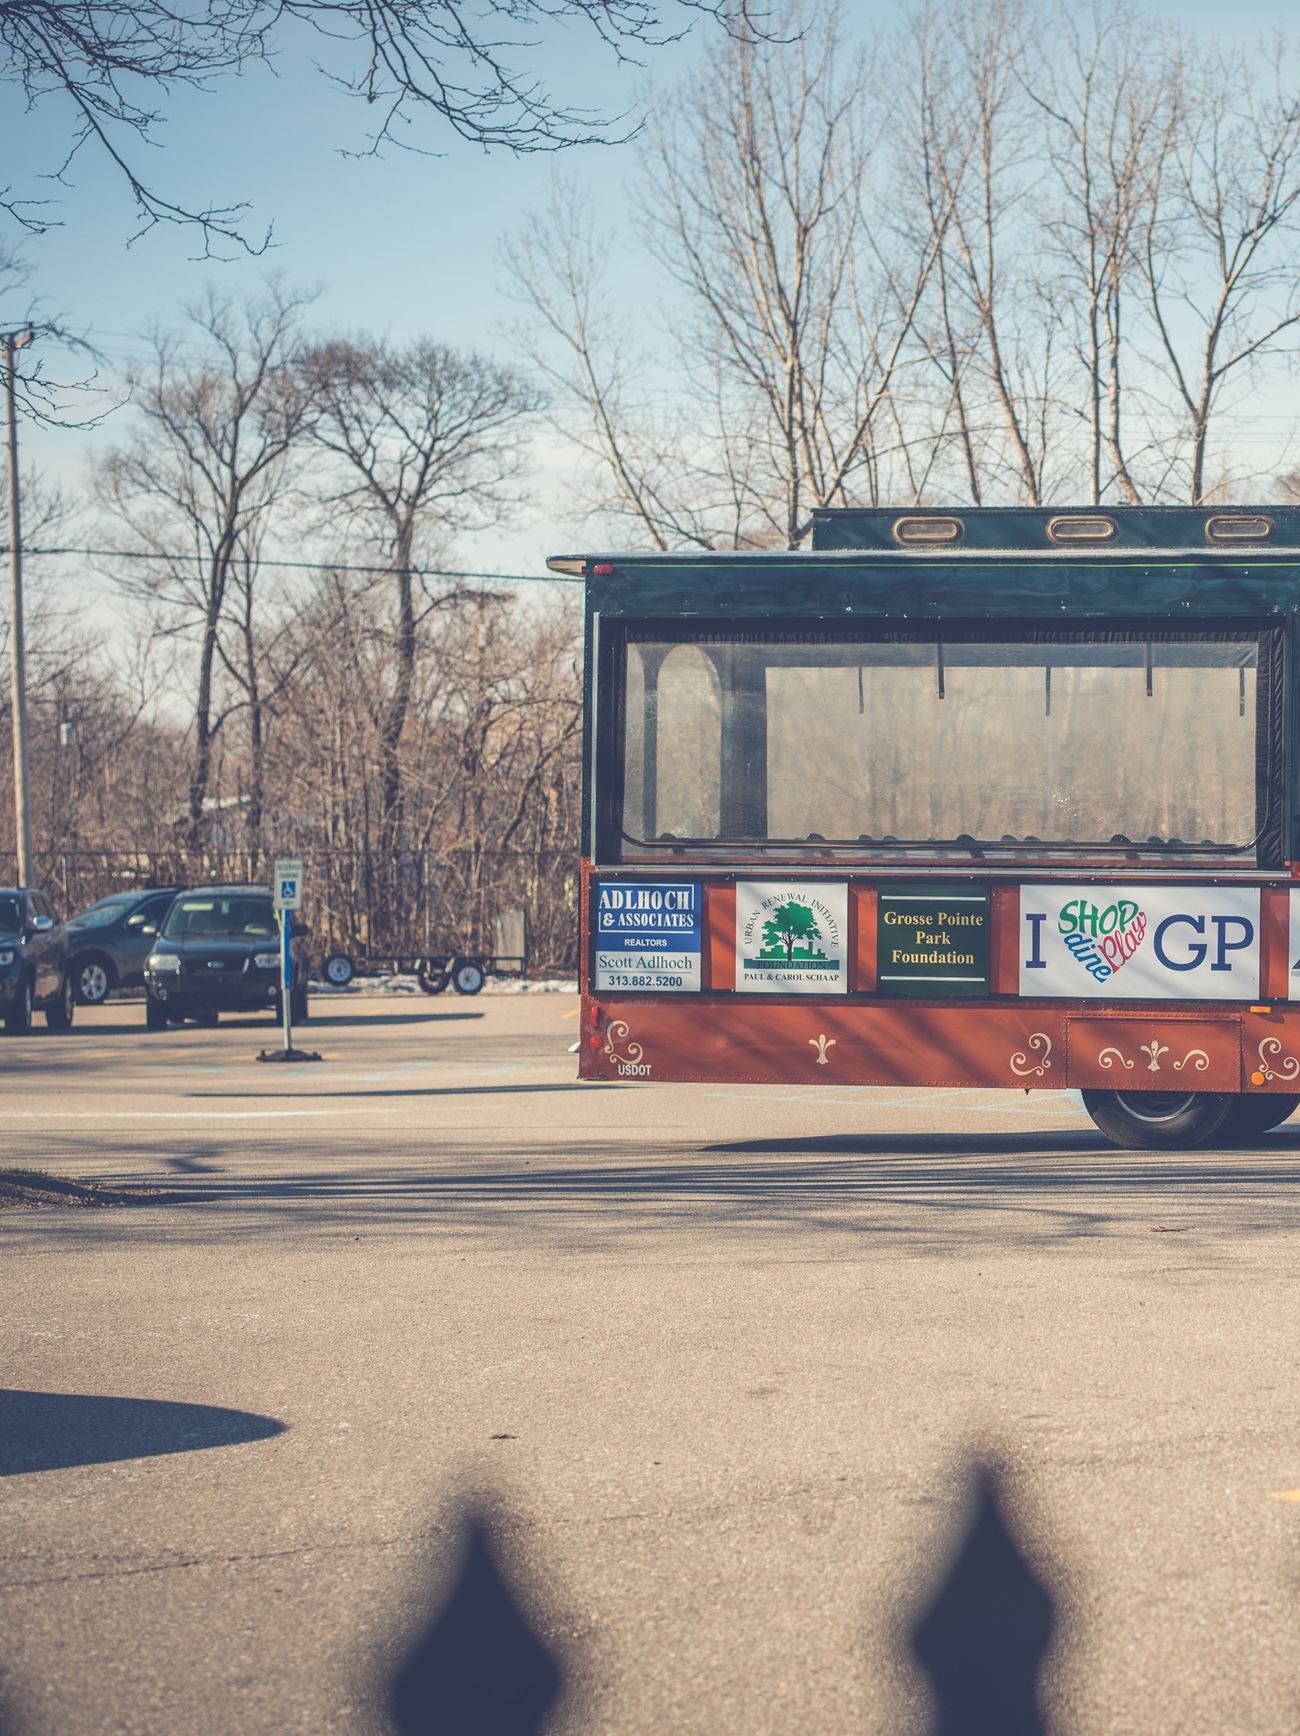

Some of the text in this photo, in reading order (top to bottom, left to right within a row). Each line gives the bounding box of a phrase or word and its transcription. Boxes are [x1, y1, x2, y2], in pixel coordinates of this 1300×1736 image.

[599, 890, 690, 910] ADLHOCH
[603, 913, 694, 927] & ASSOCIATES
[744, 892, 839, 948] URBAN RENEWAL INITIATIVE
[884, 911, 984, 926] Grosse Pointe
[1058, 900, 1139, 938] SHOP
[624, 939, 668, 947] REALTORS
[916, 930, 951, 944] Park
[1026, 914, 1254, 972] I GP
[600, 955, 692, 969] Scott Adlhoch
[892, 950, 974, 964] Foundation
[1064, 933, 1111, 984] dine
[758, 961, 826, 969] FOUNDATION
[608, 976, 682, 986] 313.882.5200
[806, 974, 840, 982] SCHAAP
[618, 1064, 652, 1076] USDOT
